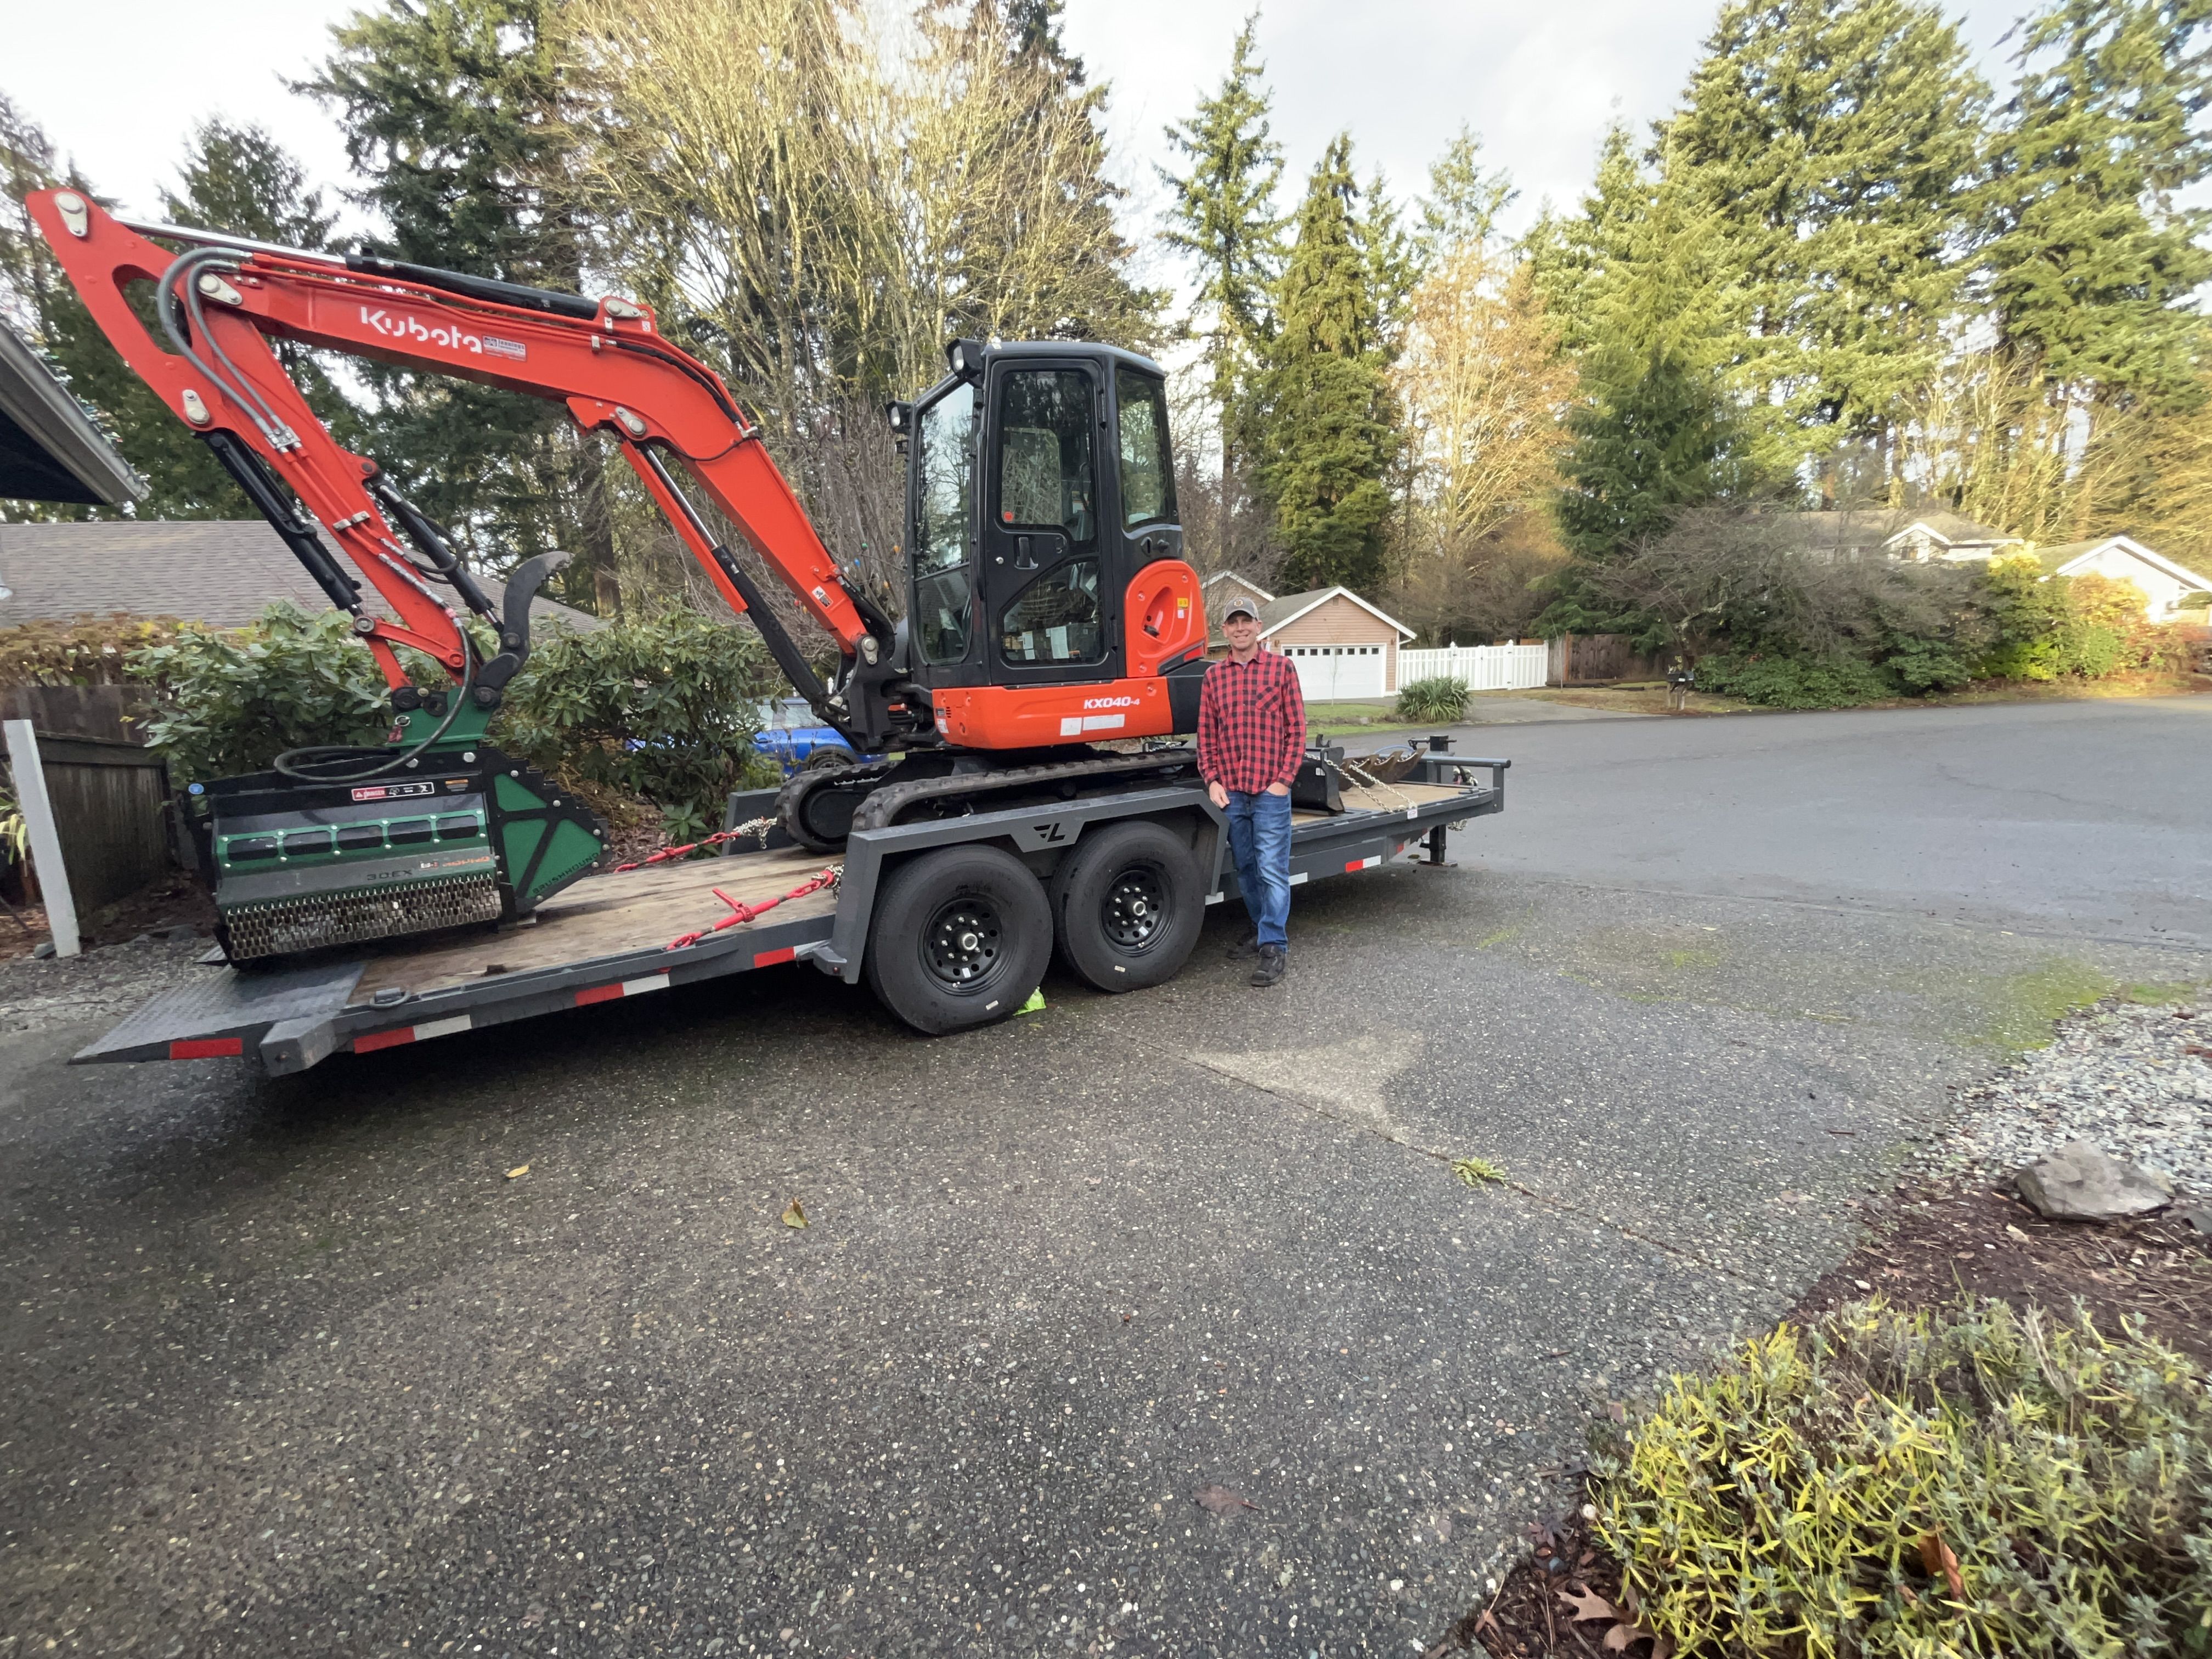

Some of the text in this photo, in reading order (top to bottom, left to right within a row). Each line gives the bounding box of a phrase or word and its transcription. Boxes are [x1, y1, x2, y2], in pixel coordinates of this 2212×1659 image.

[360, 307, 482, 354] Kubota
[1084, 696, 1140, 709] KX040-4
[532, 852, 599, 894] BRUSHHOUND
